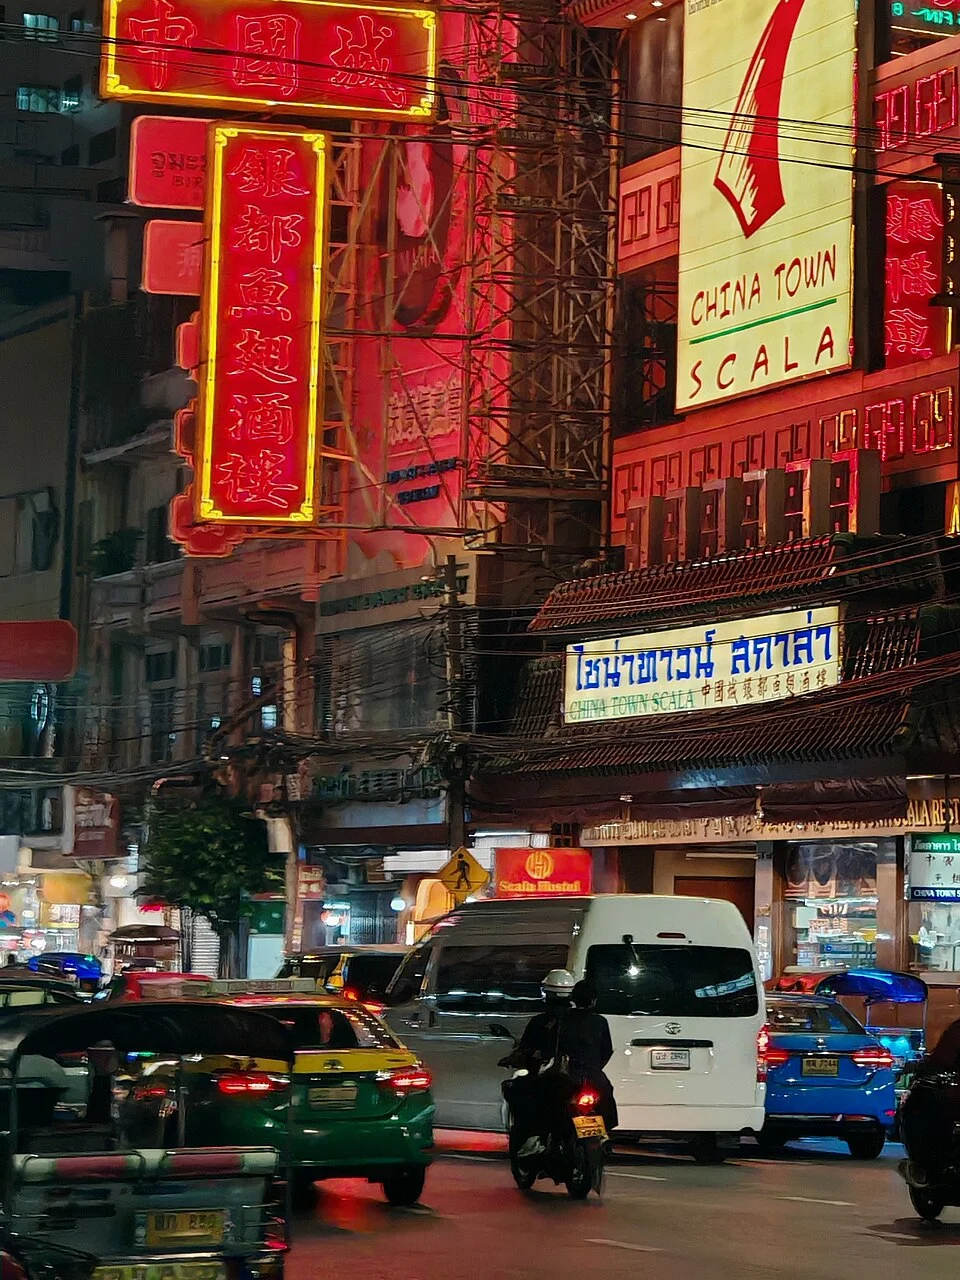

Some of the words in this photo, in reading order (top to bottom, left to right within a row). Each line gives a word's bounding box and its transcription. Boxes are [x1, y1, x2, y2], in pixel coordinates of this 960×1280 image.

[690, 272, 762, 327] CHINA
[774, 244, 837, 301] TOWN
[215, 148, 310, 509] 銀都魚翅酒樓
[690, 325, 835, 399] SCALA
[573, 629, 717, 691] ไชน่าทาวน์
[730, 610, 833, 675] สกาล่า
[570, 697, 606, 720] CHINA
[611, 694, 649, 716] TOWN
[653, 689, 695, 710] SCALA
[914, 889, 935, 898] CHINA
[936, 889, 956, 898] TOWN
